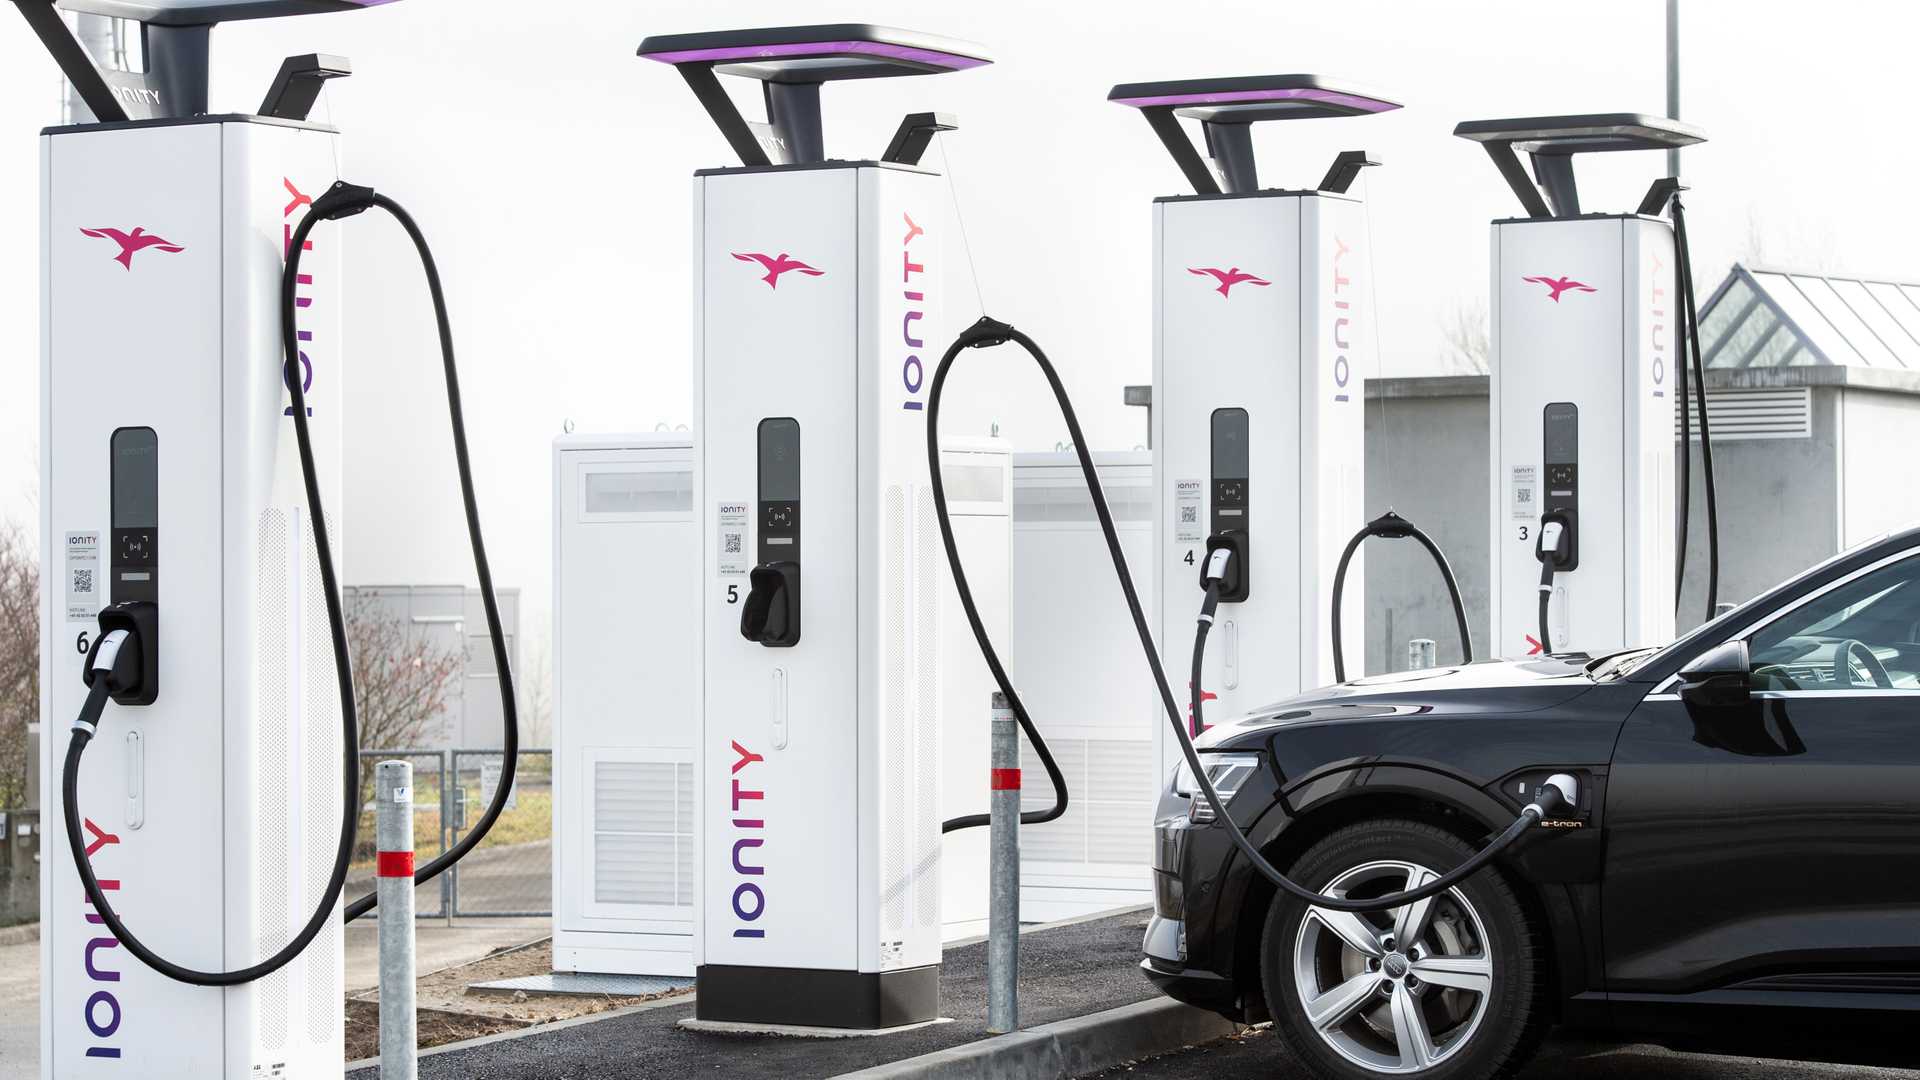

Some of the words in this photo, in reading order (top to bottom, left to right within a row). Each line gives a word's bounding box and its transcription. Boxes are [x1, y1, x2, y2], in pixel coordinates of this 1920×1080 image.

[111, 86, 160, 105] ONITY
[903, 211, 924, 411] IONITY
[1335, 234, 1350, 402] IONITY
[1652, 251, 1664, 398] IONITY
[69, 536, 97, 545] IONITY
[1519, 526, 1528, 541] 3
[1183, 549, 1195, 566] 4
[727, 585, 738, 604] 5
[76, 630, 90, 654] 6
[1541, 820, 1582, 828] e-tron
[732, 739, 764, 938] IONITY
